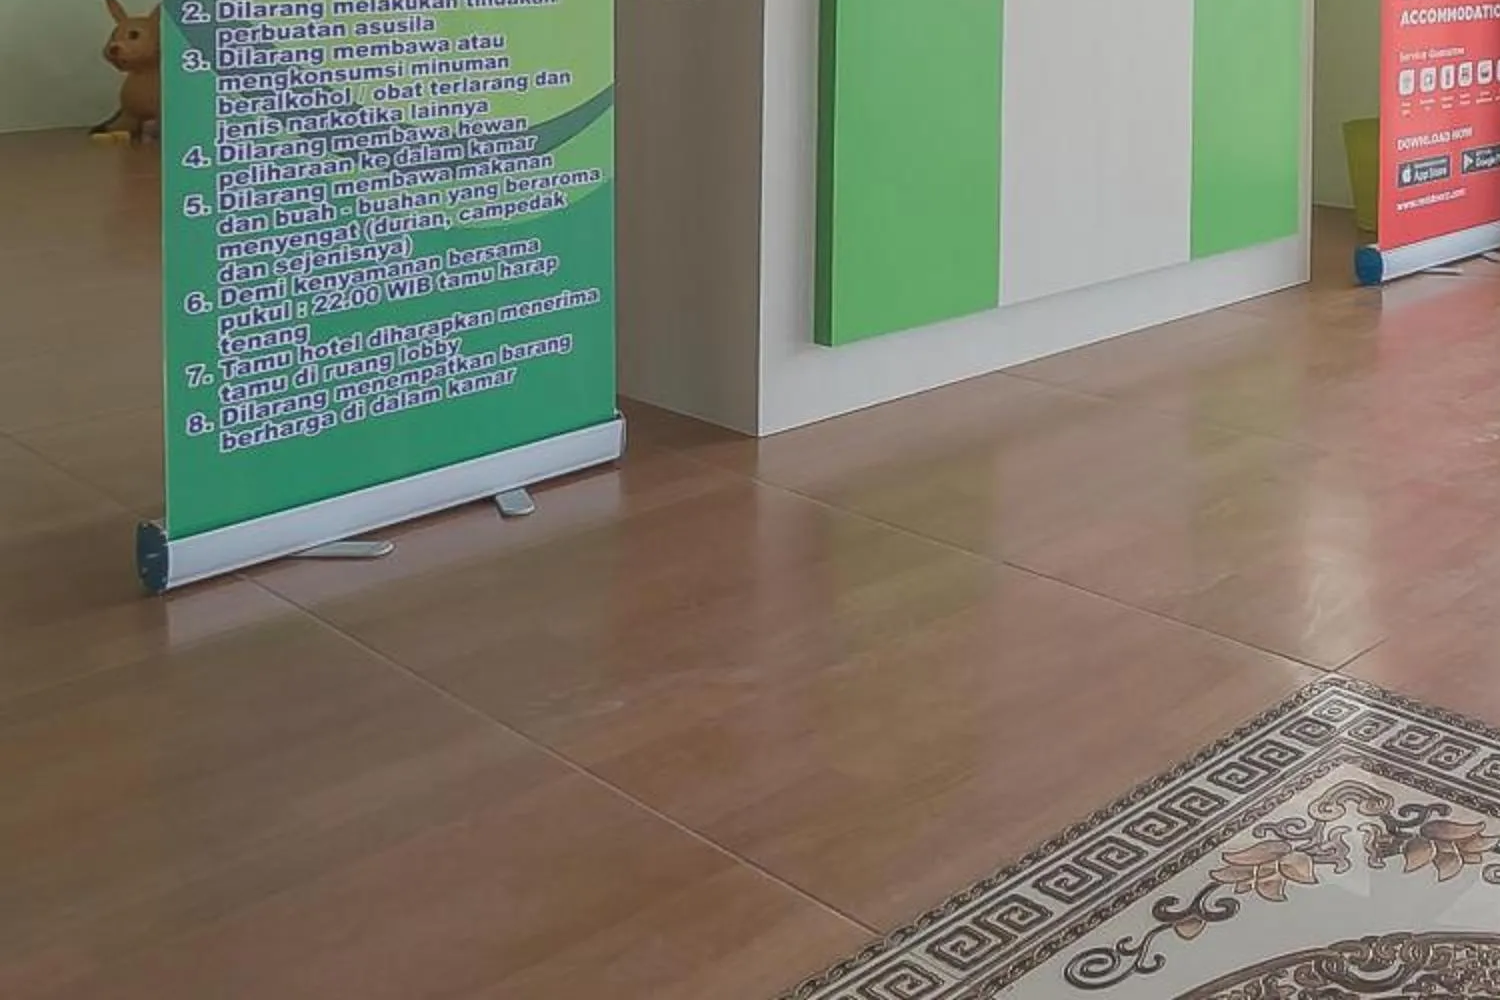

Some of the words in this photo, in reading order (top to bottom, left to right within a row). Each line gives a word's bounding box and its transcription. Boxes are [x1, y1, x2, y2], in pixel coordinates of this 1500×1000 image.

[182, 3, 210, 22] 2.
[218, 1, 324, 20] Dilarang
[218, 23, 346, 47] perbuatan
[355, 16, 435, 36] asusila
[183, 51, 210, 70] 3.
[218, 48, 324, 67] Dilarang
[333, 39, 450, 60] membawa
[457, 35, 505, 51] atau
[218, 65, 403, 91] mengkonsumsi
[412, 57, 509, 75] minuman
[218, 87, 351, 116] beralkohol
[373, 82, 422, 101] obat
[430, 74, 528, 96] terlarang
[535, 71, 571, 87] dan
[183, 147, 211, 167] 4.
[218, 138, 326, 163] Dilarang
[333, 126, 450, 150] membawa
[457, 118, 527, 137] hewan
[216, 120, 280, 144] jenis
[289, 107, 403, 132] narkotika
[411, 100, 489, 119] lainnya
[184, 196, 211, 216] 5.
[218, 185, 326, 211] Dilarang
[333, 169, 451, 196] membawa
[457, 154, 553, 179] makanan
[218, 158, 353, 191] peliharaan
[361, 153, 390, 170] ke
[394, 146, 463, 166] dalam
[470, 136, 537, 156] kamar
[218, 215, 267, 235] dan
[275, 204, 335, 227] buah
[357, 190, 440, 215] buahan
[448, 184, 499, 205] yang
[505, 169, 600, 193] beraroma
[219, 224, 359, 259] menyengat
[365, 213, 451, 241] (durian,
[458, 192, 566, 221] campedak
[185, 292, 212, 314] 6.
[219, 278, 287, 307] Demi
[293, 257, 441, 294] kenyamanan
[449, 239, 540, 265] bersama
[218, 262, 268, 284] dan
[274, 235, 412, 274] sejenisnya)
[219, 301, 291, 335] pukul
[313, 286, 380, 315] 22.00
[387, 278, 432, 299] WIB
[439, 268, 494, 290] tamu
[500, 256, 558, 278] harap
[186, 364, 213, 387] 7.
[219, 353, 291, 379] Tamu
[299, 333, 361, 363] hotel
[368, 310, 493, 348] diharapkan
[499, 289, 598, 321] menerima
[219, 325, 309, 355] tenang
[187, 414, 214, 434] 8.
[220, 391, 327, 427] Dilarang
[335, 353, 495, 400] menempatkan
[501, 334, 572, 362] barang
[220, 376, 287, 402] tamu
[294, 366, 317, 386] di
[325, 353, 393, 380] ruang
[400, 338, 462, 363] lobby
[220, 412, 335, 451] berharga
[342, 401, 366, 422] di
[371, 387, 441, 415] dalam
[448, 368, 516, 397] kamar
